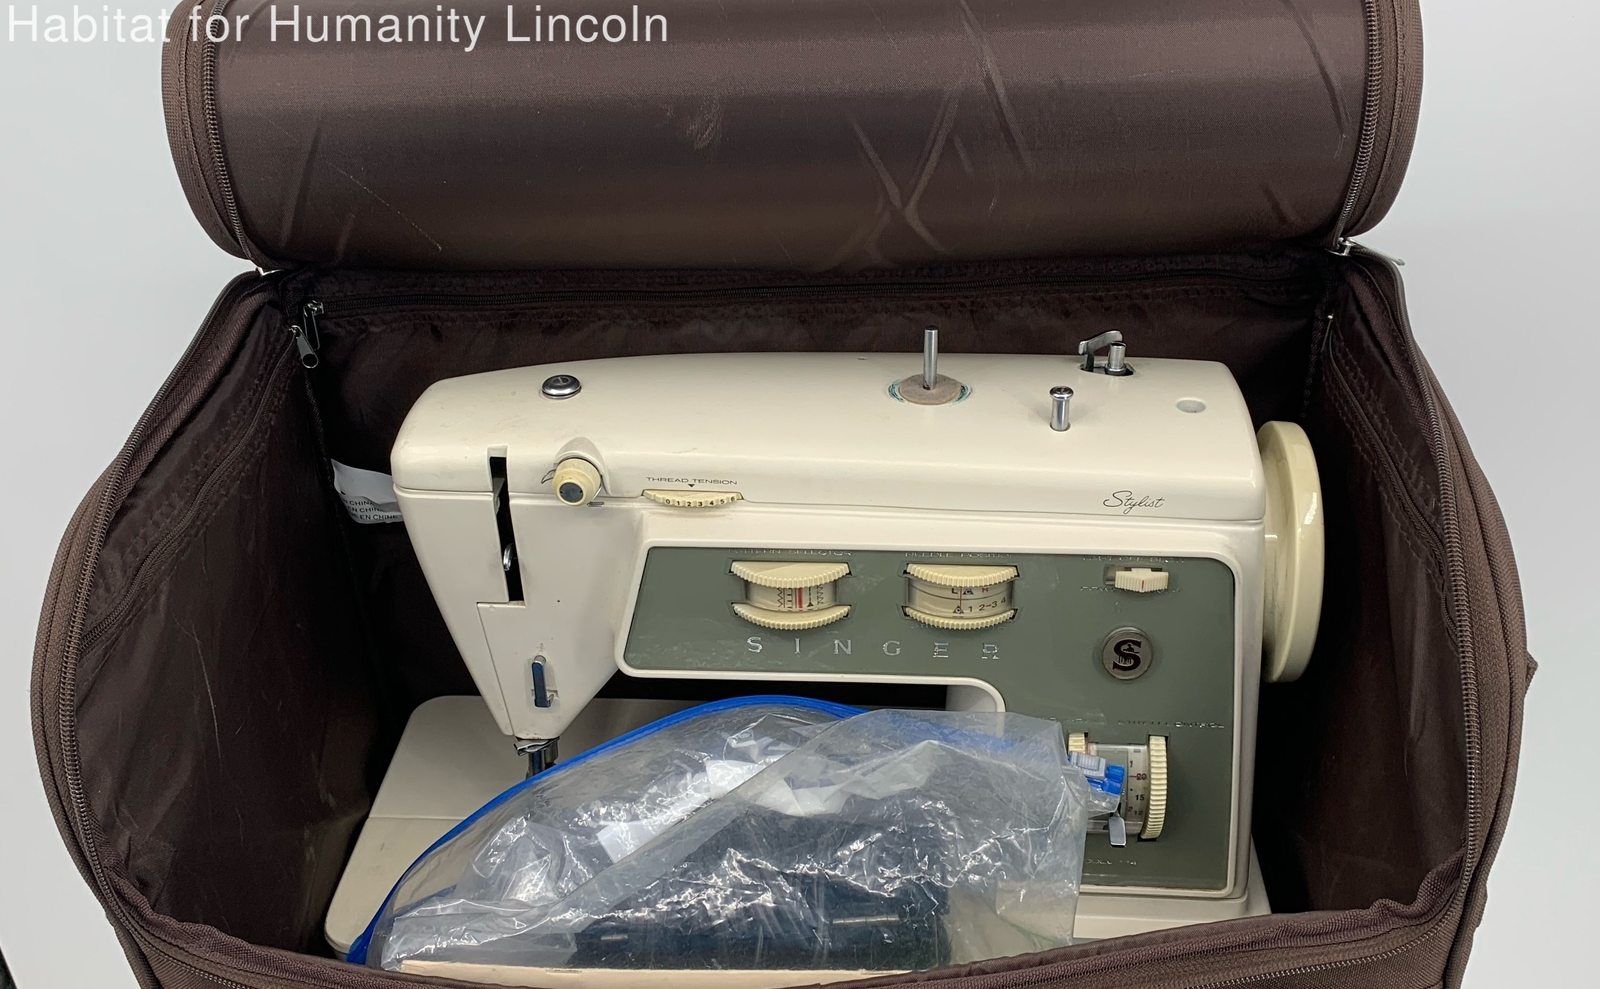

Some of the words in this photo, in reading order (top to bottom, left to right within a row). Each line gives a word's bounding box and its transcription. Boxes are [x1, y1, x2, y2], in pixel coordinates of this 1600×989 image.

[1102, 490, 1166, 515] Stylist
[746, 636, 1000, 660] SINGER
[1112, 639, 1142, 671] S
